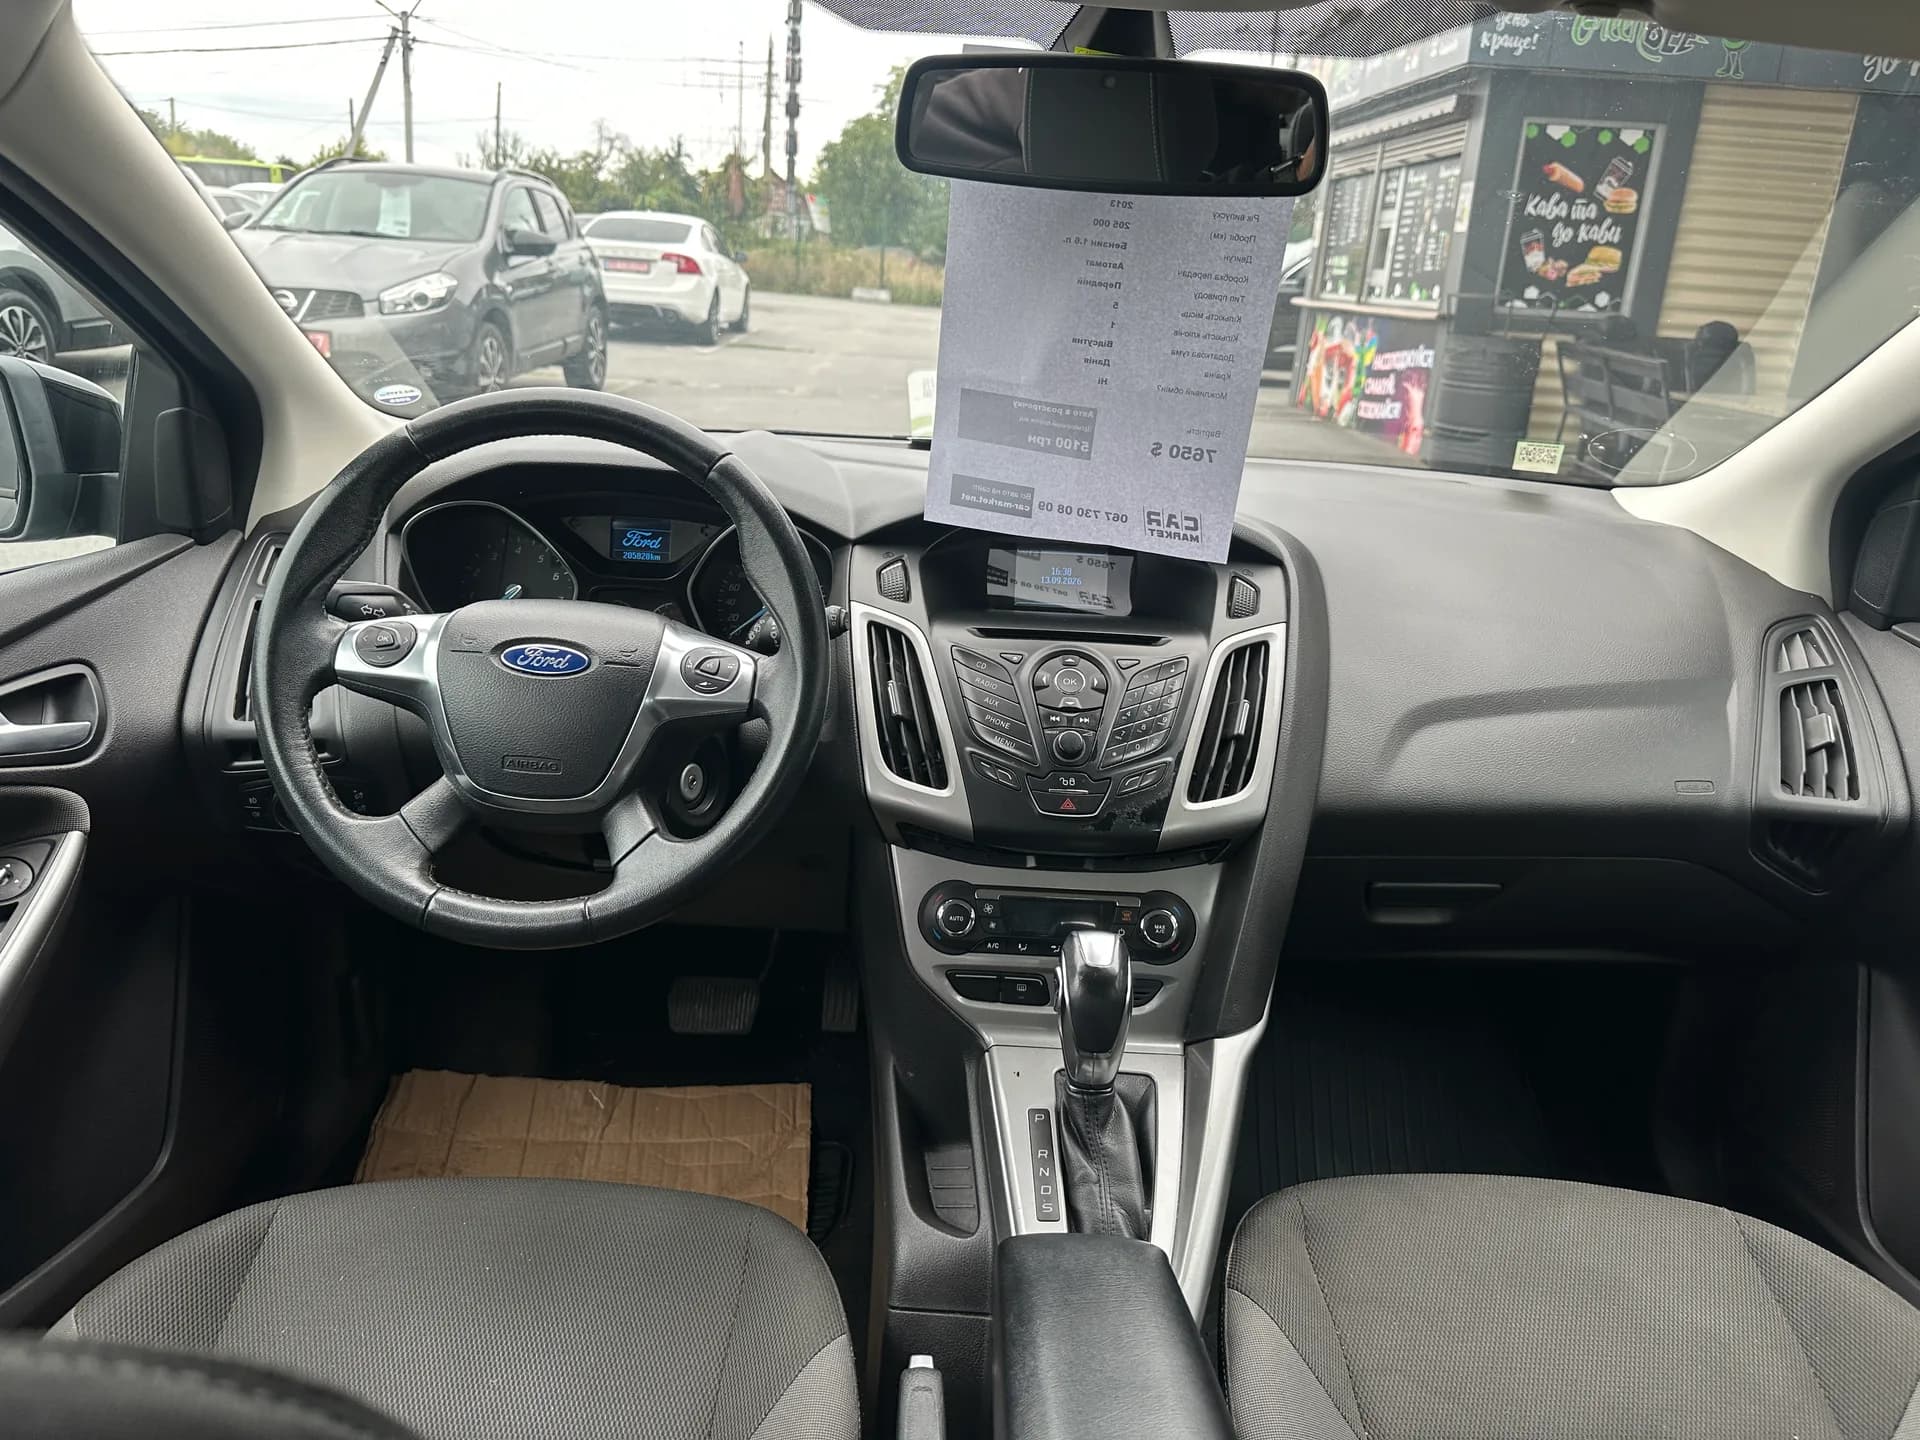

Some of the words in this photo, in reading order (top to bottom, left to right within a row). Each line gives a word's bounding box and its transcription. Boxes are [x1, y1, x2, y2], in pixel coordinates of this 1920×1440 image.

[1524, 192, 1567, 220] Кава
[1577, 217, 1622, 244] кави
[622, 530, 663, 549] Ford
[376, 634, 390, 642] OK
[516, 646, 572, 669] Ford
[975, 661, 987, 670] CD
[975, 677, 998, 690] RADIO
[1062, 677, 1078, 687] OK
[984, 697, 1000, 707] AUX
[985, 714, 1012, 730] PHONE
[994, 735, 1016, 749] MENU
[505, 758, 560, 771] AIRBAG
[1034, 1113, 1045, 1123] P
[1037, 1149, 1049, 1159] R
[1039, 1167, 1050, 1177] N
[1040, 1185, 1052, 1195] D
[1041, 1202, 1054, 1213] S
